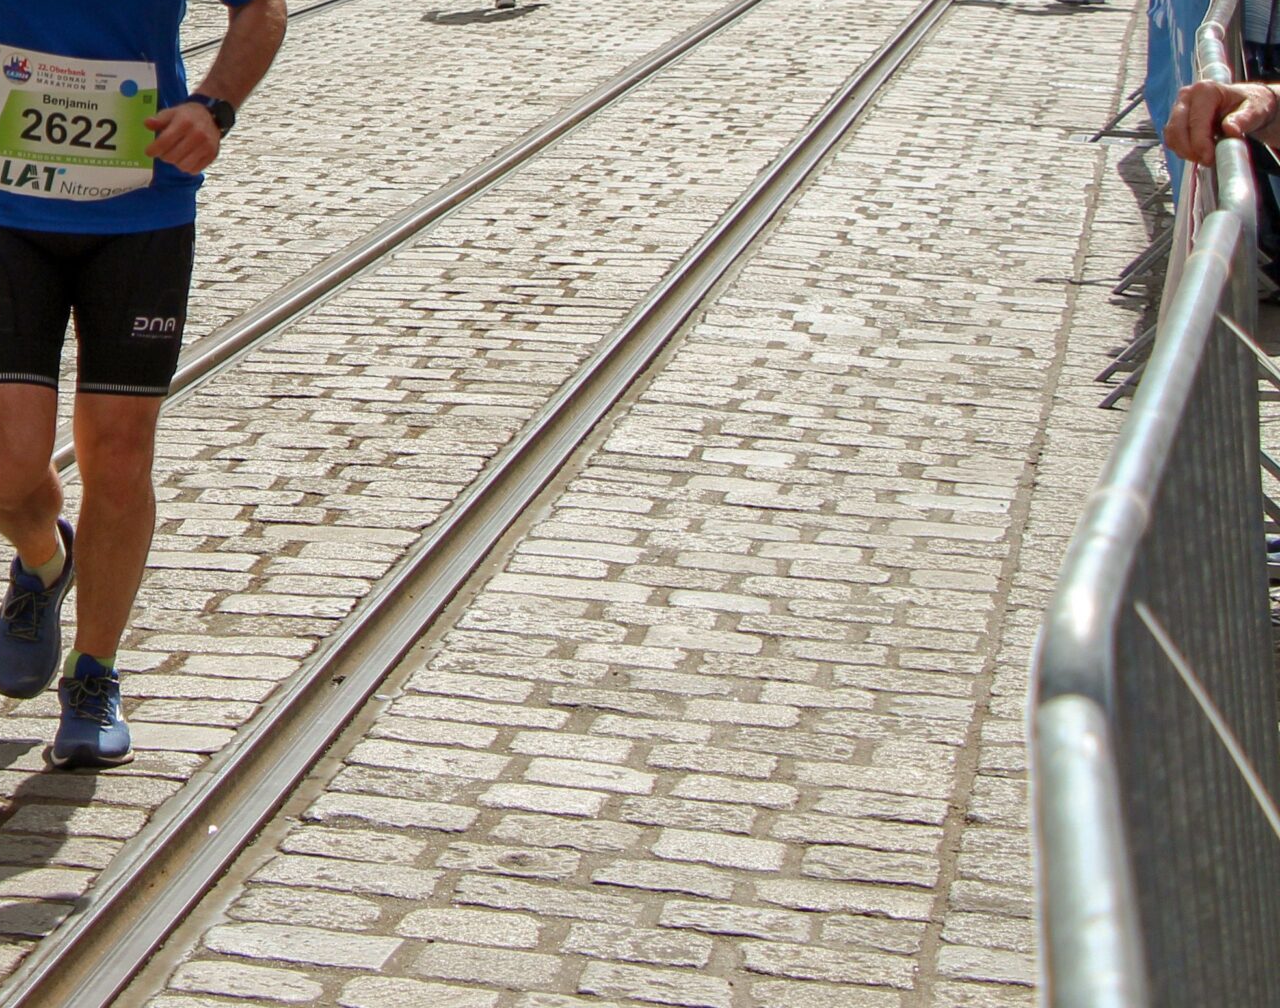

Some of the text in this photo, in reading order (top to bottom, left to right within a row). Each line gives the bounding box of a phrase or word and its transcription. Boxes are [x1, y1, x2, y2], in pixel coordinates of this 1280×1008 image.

[49, 65, 86, 76] Oberbank
[36, 78, 87, 90] MARATHON
[57, 74, 87, 84] DONAU
[42, 94, 98, 112] Benjamin
[20, 108, 118, 151] 2622
[0, 159, 58, 192] LAT
[133, 317, 176, 332] DNA
